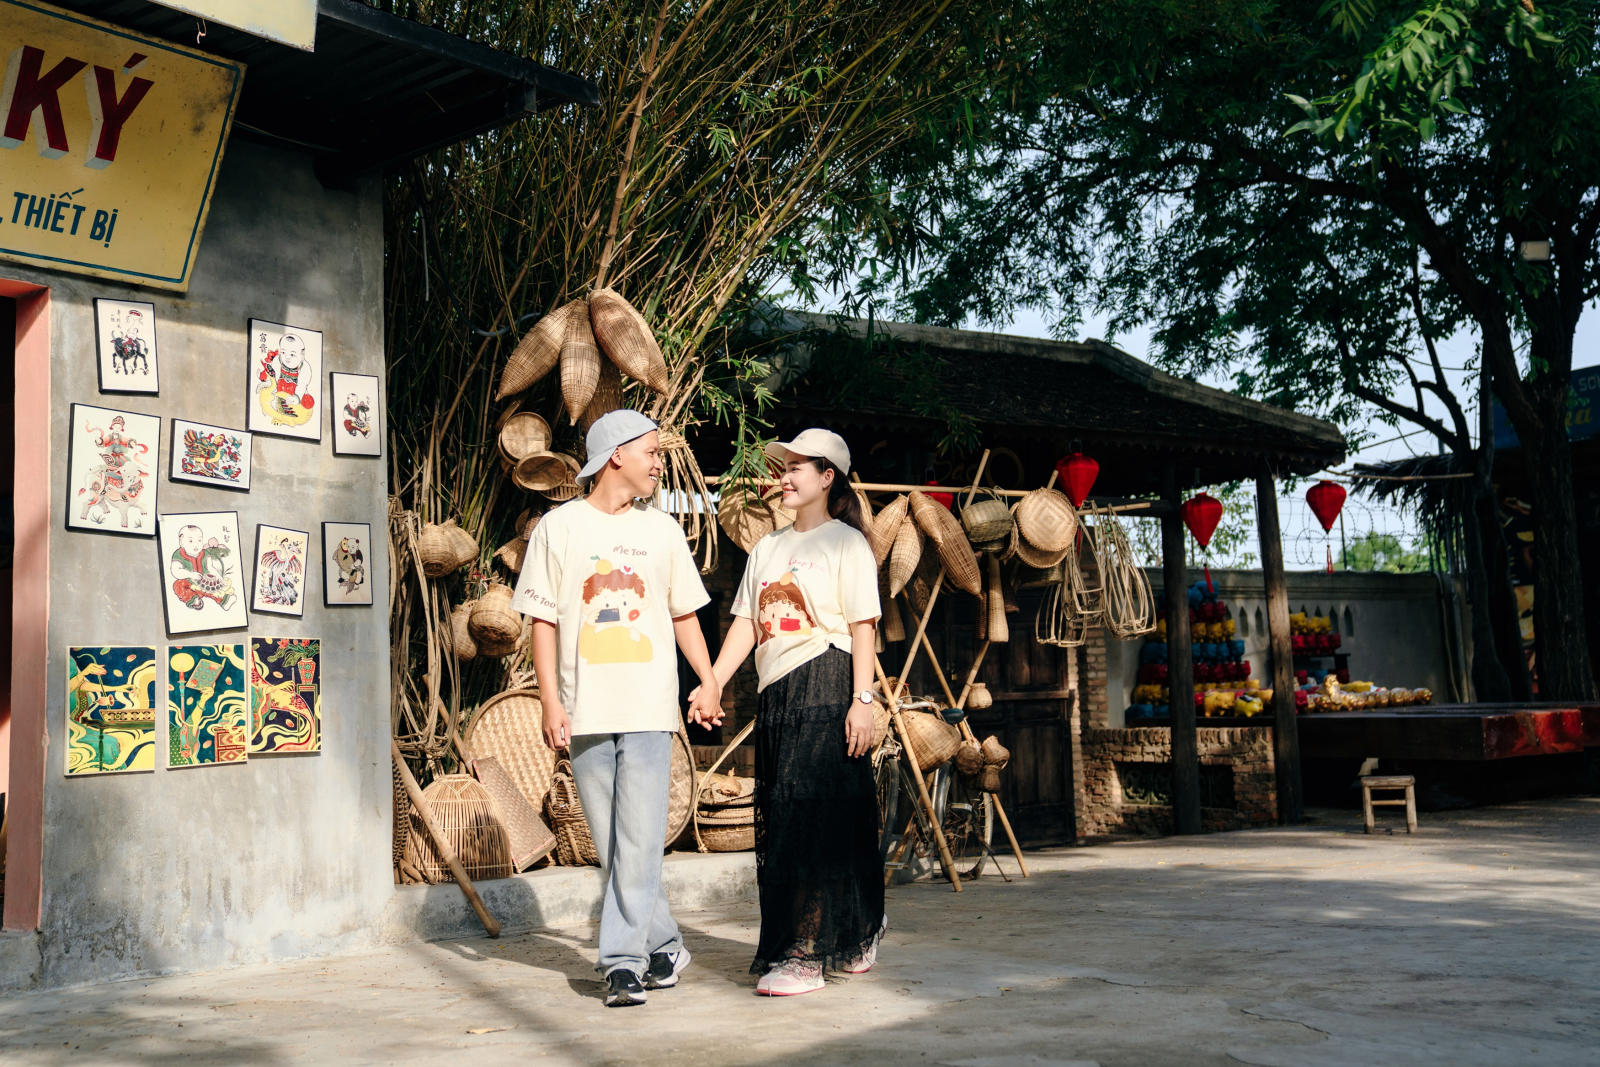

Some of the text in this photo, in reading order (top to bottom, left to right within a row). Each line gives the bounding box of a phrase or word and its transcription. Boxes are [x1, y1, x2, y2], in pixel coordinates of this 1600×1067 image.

[0, 45, 155, 171] KÝ
[11, 188, 119, 248] THIẾT BỊ
[612, 545, 648, 556] Me Too
[524, 588, 556, 609] Me Too
